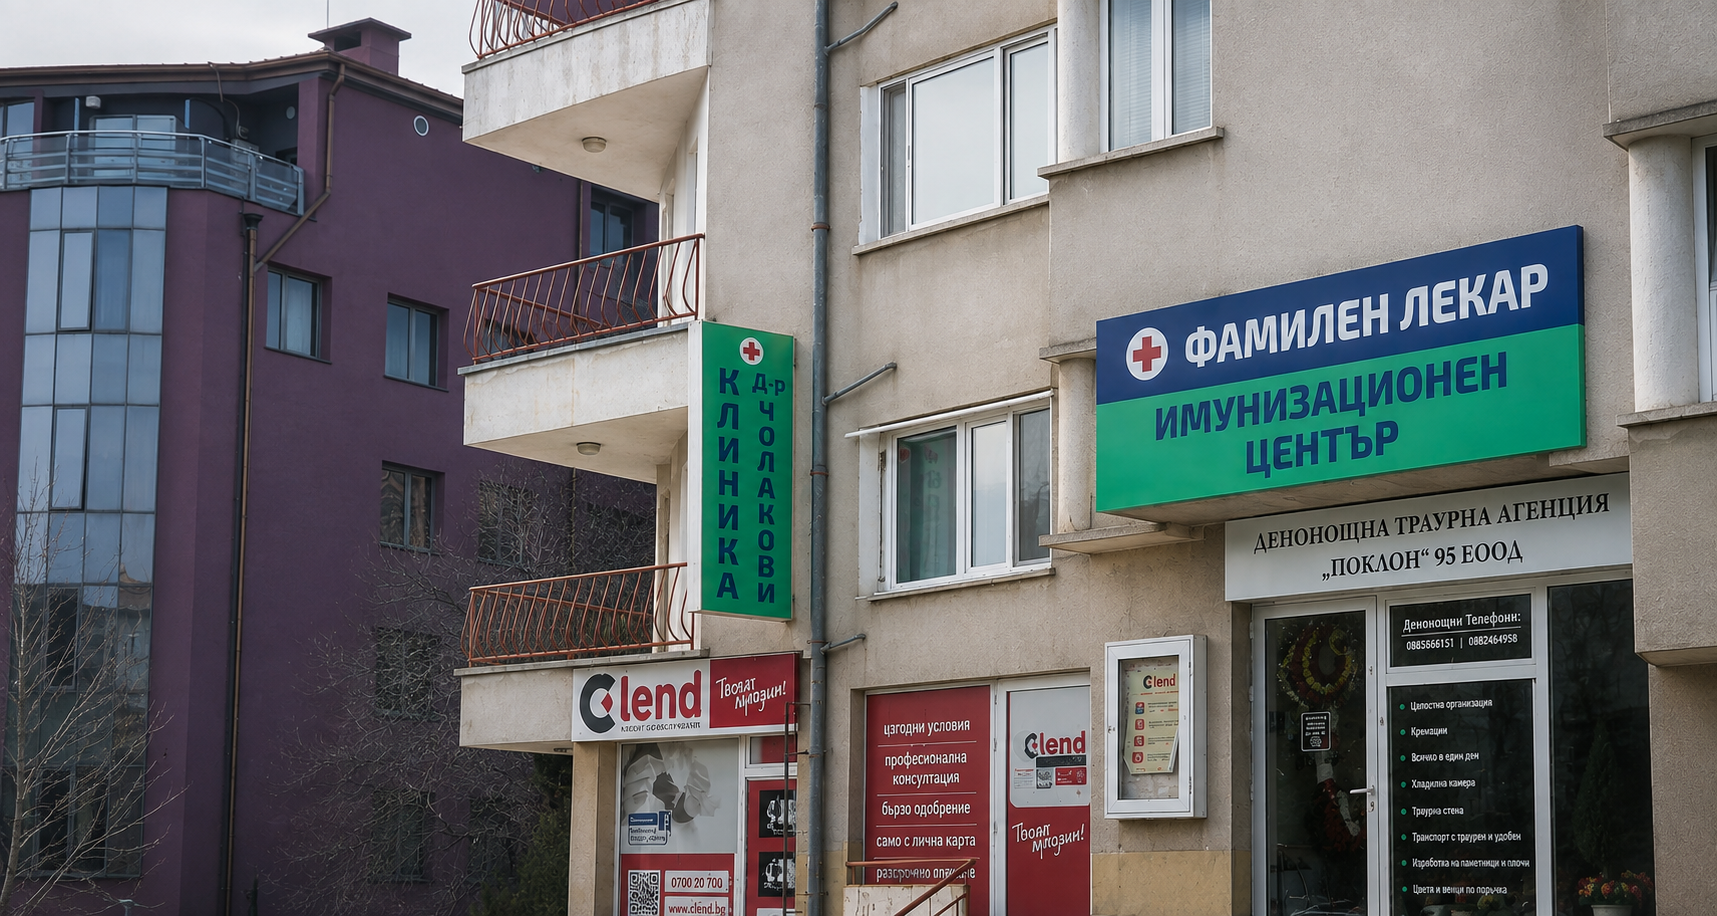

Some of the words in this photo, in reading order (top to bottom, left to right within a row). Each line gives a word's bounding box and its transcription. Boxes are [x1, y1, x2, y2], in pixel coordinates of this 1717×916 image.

[1185, 293, 1389, 368] ФАМИЛЕН
[1400, 263, 1549, 331] ЛЕКАР
[1155, 351, 1507, 441] ИМУНИЗАЦИОНЕН
[1245, 421, 1399, 478] ЦЕНТЪР
[716, 367, 740, 600] КЛИНИКА
[757, 401, 776, 604] ЧОЛАКОВИ
[1253, 518, 1389, 554] ДЕНОНОЩНА
[1394, 507, 1492, 535] ТРАУРНА
[1497, 492, 1610, 524] АГЕНЦИЯ
[1321, 547, 1430, 582] „ПОКЛОН“
[1434, 546, 1456, 567] 95
[1461, 539, 1523, 564] ЕООД
[928, 720, 970, 736] условия
[1411, 727, 1448, 738] Кремации
[885, 751, 967, 770] професионална
[1439, 753, 1444, 761] в
[893, 772, 960, 789] консултация
[914, 800, 971, 819] одобрение
[1442, 807, 1464, 815] стена
[876, 836, 902, 847] само
[904, 836, 910, 847] с
[912, 836, 943, 847] лична
[946, 835, 976, 850] карта
[671, 877, 692, 889] 0700
[694, 877, 705, 889] 20
[707, 877, 723, 889] 700
